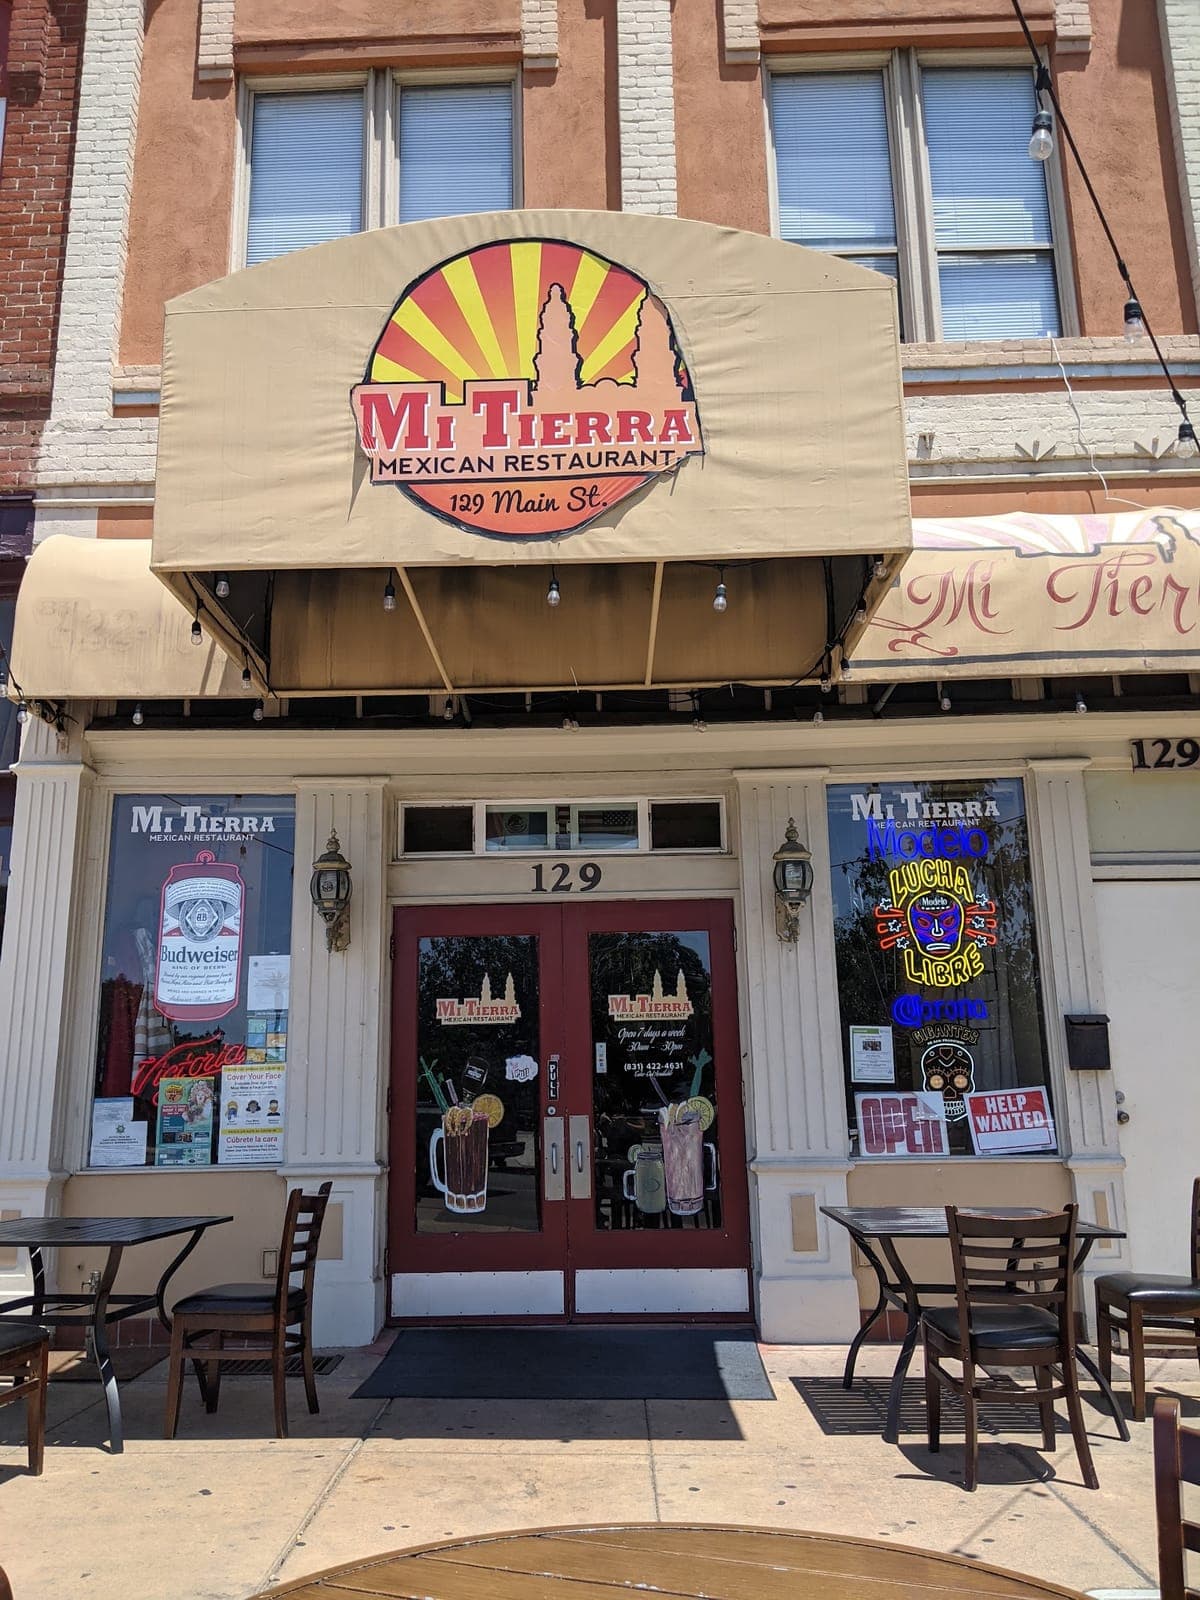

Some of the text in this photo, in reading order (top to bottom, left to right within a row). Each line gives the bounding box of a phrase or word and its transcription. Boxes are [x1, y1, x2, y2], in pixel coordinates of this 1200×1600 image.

[472, 390, 695, 448] TIERRA
[378, 450, 677, 475] MEXICAN RESTAURANT
[450, 485, 609, 514] 129 Main St.
[906, 551, 1200, 634] Mi Tier
[1132, 737, 1200, 769] 129
[901, 792, 1000, 819] TIERRA
[181, 806, 275, 833] TIERRA
[918, 818, 982, 828] RESTAURANT
[149, 834, 255, 842] MEXICAN RESTAURANT
[867, 815, 989, 862] Modelo
[530, 862, 602, 892] 129
[890, 859, 974, 908] LUCHA
[160, 945, 239, 963] Budweiser
[904, 942, 984, 987] LIBRE
[465, 1000, 519, 1016] TIERRA
[637, 996, 691, 1012] TIERRA
[892, 994, 988, 1027] Corona
[911, 1023, 980, 1045] GIGANTES
[131, 1032, 246, 1095] Victoria
[226, 1073, 247, 1081] Cover
[265, 1072, 282, 1080] Face
[646, 1062, 683, 1070] 422-4631
[549, 1065, 557, 1097] PULL
[985, 1094, 1027, 1114] HELP
[975, 1111, 1046, 1133] WANTED
[226, 1136, 253, 1144] Cúbrete
